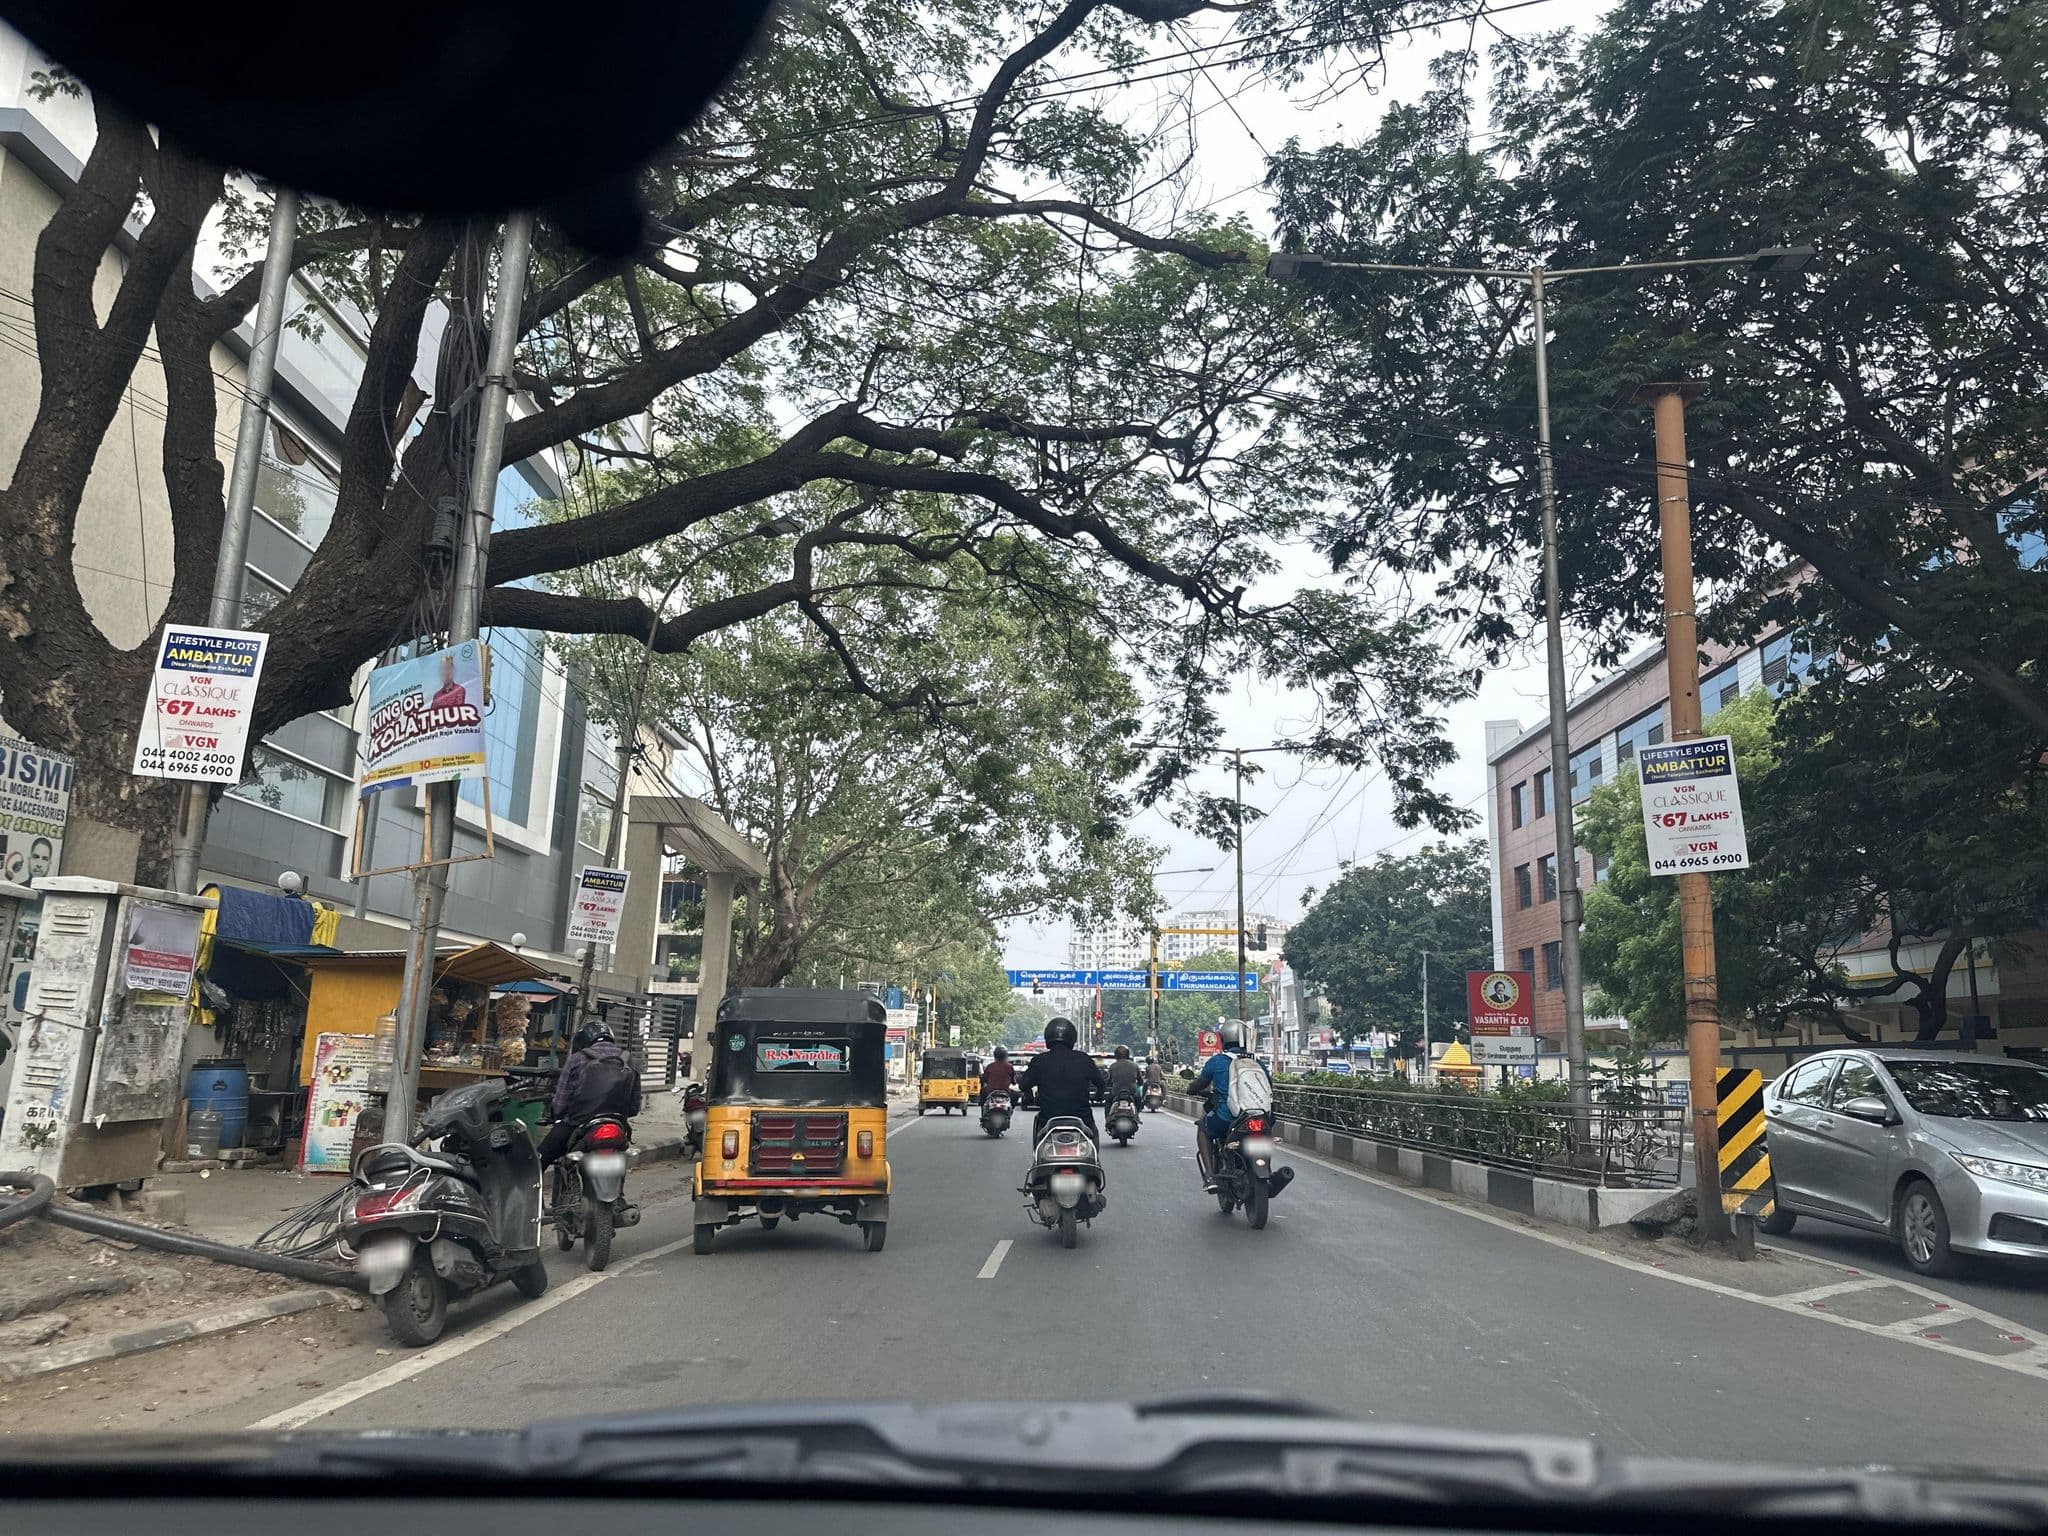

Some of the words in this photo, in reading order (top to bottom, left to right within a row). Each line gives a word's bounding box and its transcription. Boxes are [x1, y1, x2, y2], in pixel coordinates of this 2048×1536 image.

[169, 635, 222, 649] LIFESTYLE
[225, 641, 258, 651] PLOTS
[167, 648, 253, 667] AMBATTUR
[189, 675, 212, 685] VGN
[163, 682, 240, 701] CLASSIQUE
[370, 701, 401, 734] KING
[403, 693, 424, 712] OF
[368, 704, 480, 760] KOLATHUR
[184, 735, 218, 749] VGN
[142, 747, 166, 759] 044
[169, 750, 201, 762] 4002
[203, 752, 235, 765] 4000
[1642, 748, 1692, 761] LIFESTYLE
[1694, 743, 1726, 754] PLOTS
[0, 747, 73, 792] BISMI
[140, 759, 165, 770] 044
[168, 762, 198, 774] 6965
[200, 765, 233, 777] 6900
[420, 760, 431, 769] 10
[1646, 755, 1726, 774] AMBATTUR
[44, 790, 59, 804] TAB
[1674, 785, 1695, 793] VGN
[1653, 790, 1727, 808] CLASSIQUE
[13, 817, 65, 840] SERVICE
[1652, 812, 1688, 828] ₹67
[1688, 841, 1718, 852] VGN
[1654, 859, 1676, 870] 044
[1680, 856, 1709, 867] 6965
[1712, 853, 1742, 865] 6900
[584, 877, 624, 888] AMBATTUR
[591, 920, 607, 928] VGN
[1474, 1016, 1509, 1025] VASANTH
[1511, 1016, 1516, 1024] &
[1518, 1016, 1529, 1025] CO
